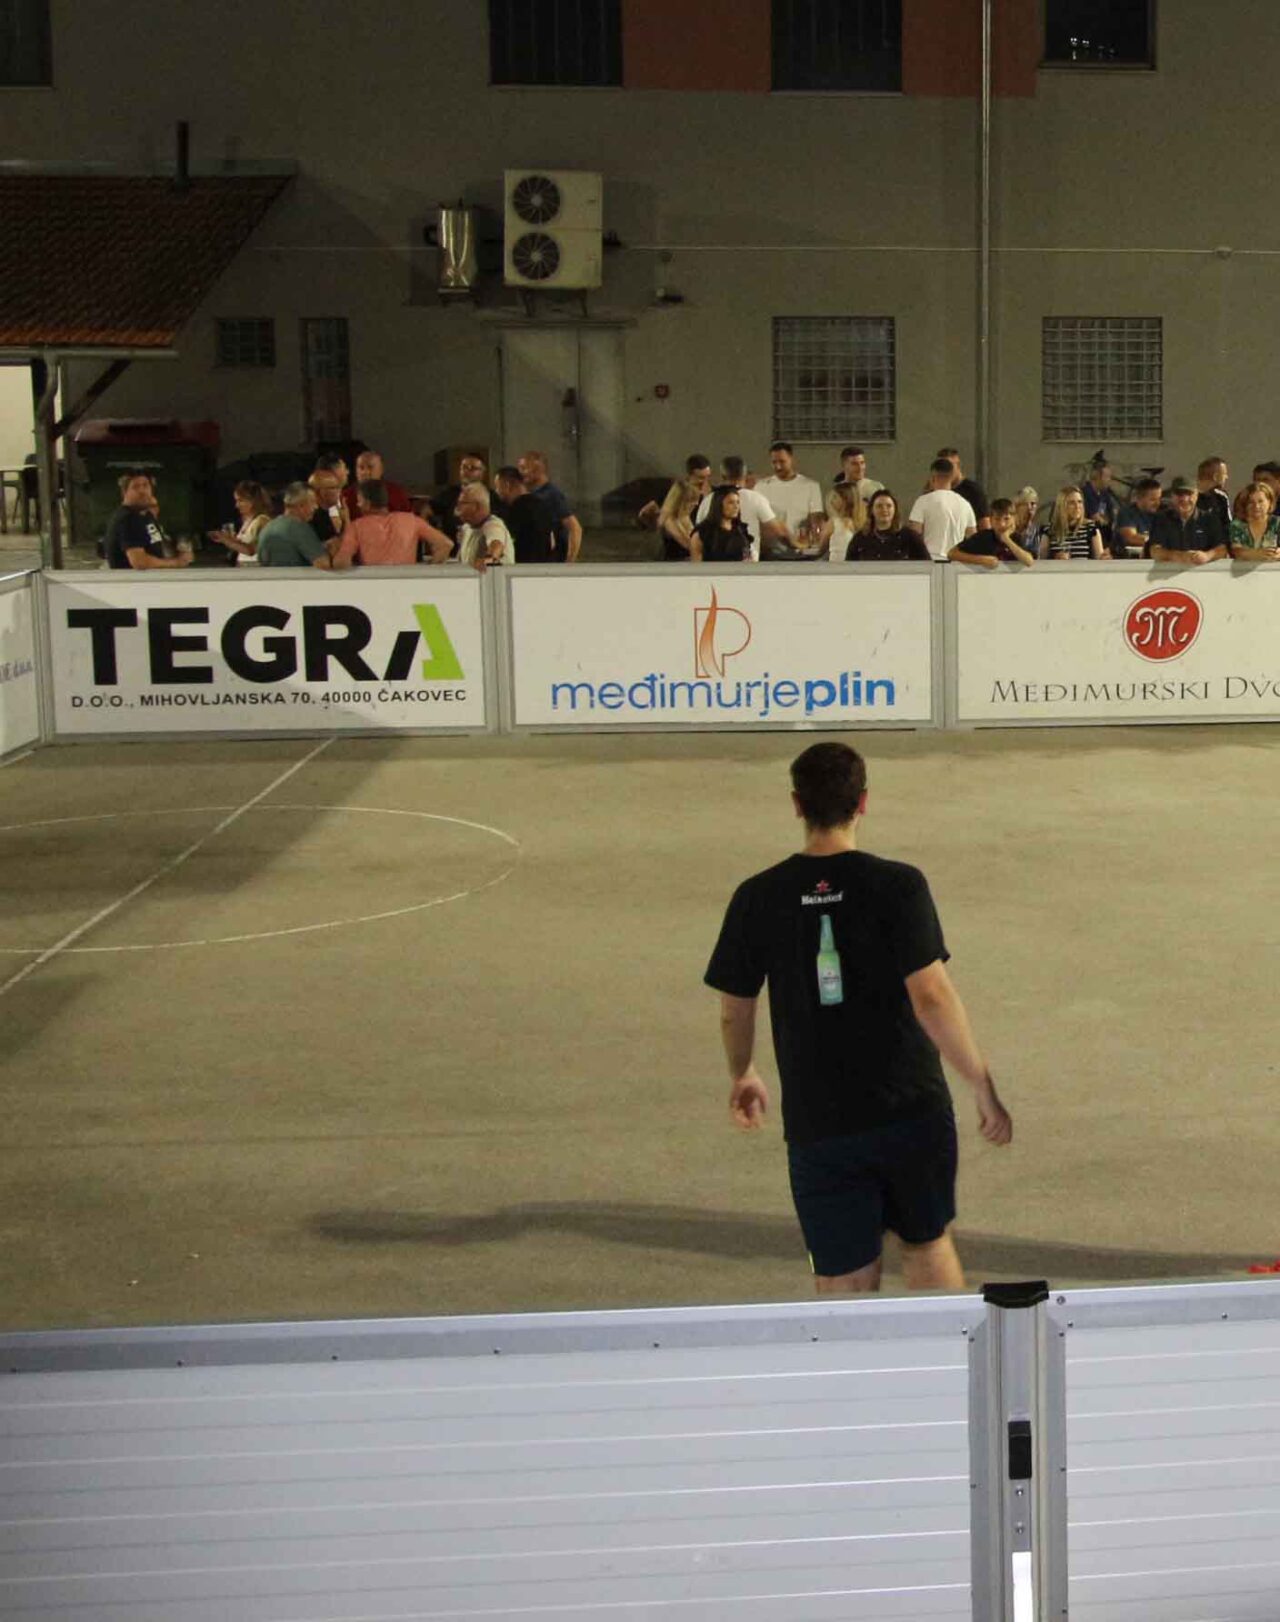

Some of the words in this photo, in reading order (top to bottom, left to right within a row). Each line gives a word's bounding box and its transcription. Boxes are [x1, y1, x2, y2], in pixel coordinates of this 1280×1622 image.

[66, 603, 465, 686] TEGRA
[139, 690, 286, 707] MIHOVLJANSKA
[321, 691, 372, 703] 40000
[376, 687, 467, 704] ČAKOVEC
[551, 670, 896, 717] međimurjeplin
[990, 678, 1210, 705] MEĐIMURSKI
